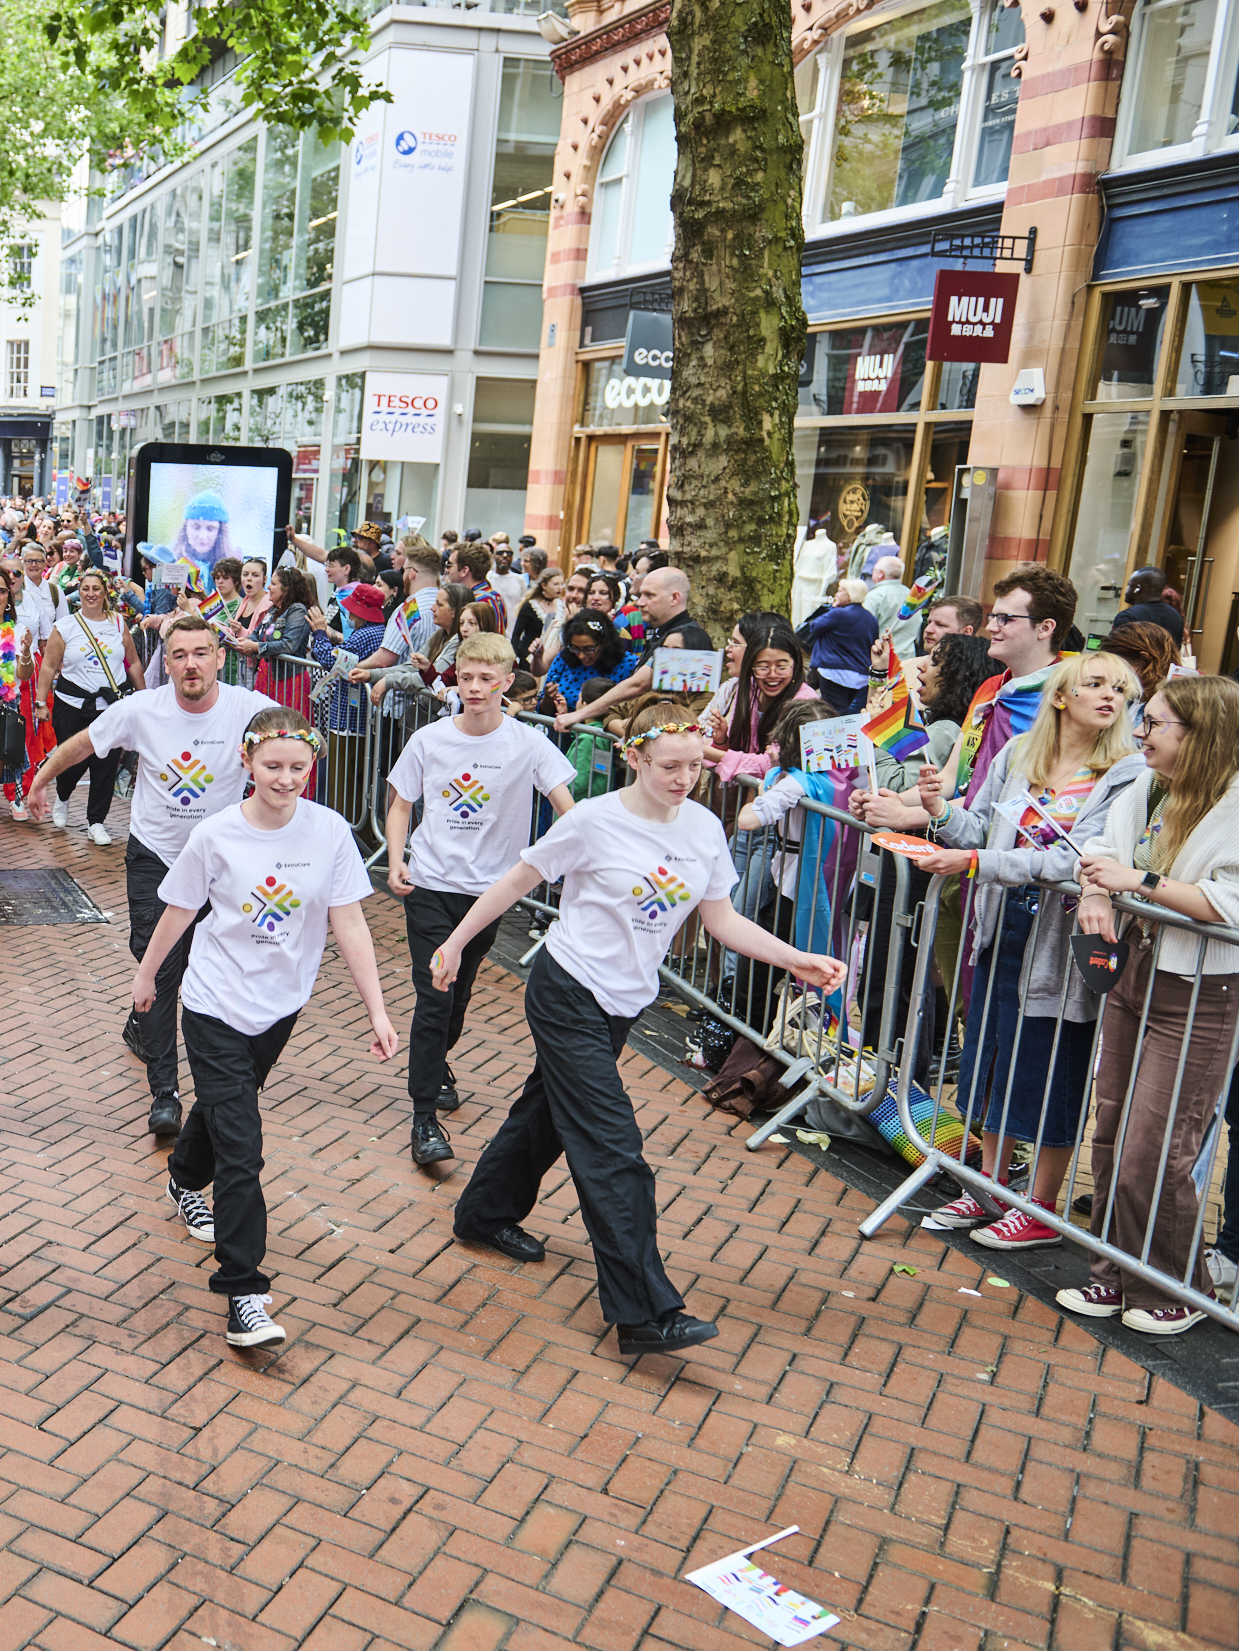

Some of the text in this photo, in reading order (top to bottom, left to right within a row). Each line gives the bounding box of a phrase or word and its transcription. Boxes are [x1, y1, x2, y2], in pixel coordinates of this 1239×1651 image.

[421, 131, 457, 142] TESCO
[420, 148, 454, 159] mobile
[947, 295, 1004, 323] MUJI
[950, 322, 994, 338] 無印良品
[633, 347, 673, 368] ecc
[855, 353, 894, 380] MUJI
[372, 393, 438, 411] TESCO
[369, 419, 437, 437] express
[812, 729, 825, 737] love
[834, 726, 846, 735] love
[165, 805, 180, 813] Pride
[878, 838, 936, 853] Cadent
